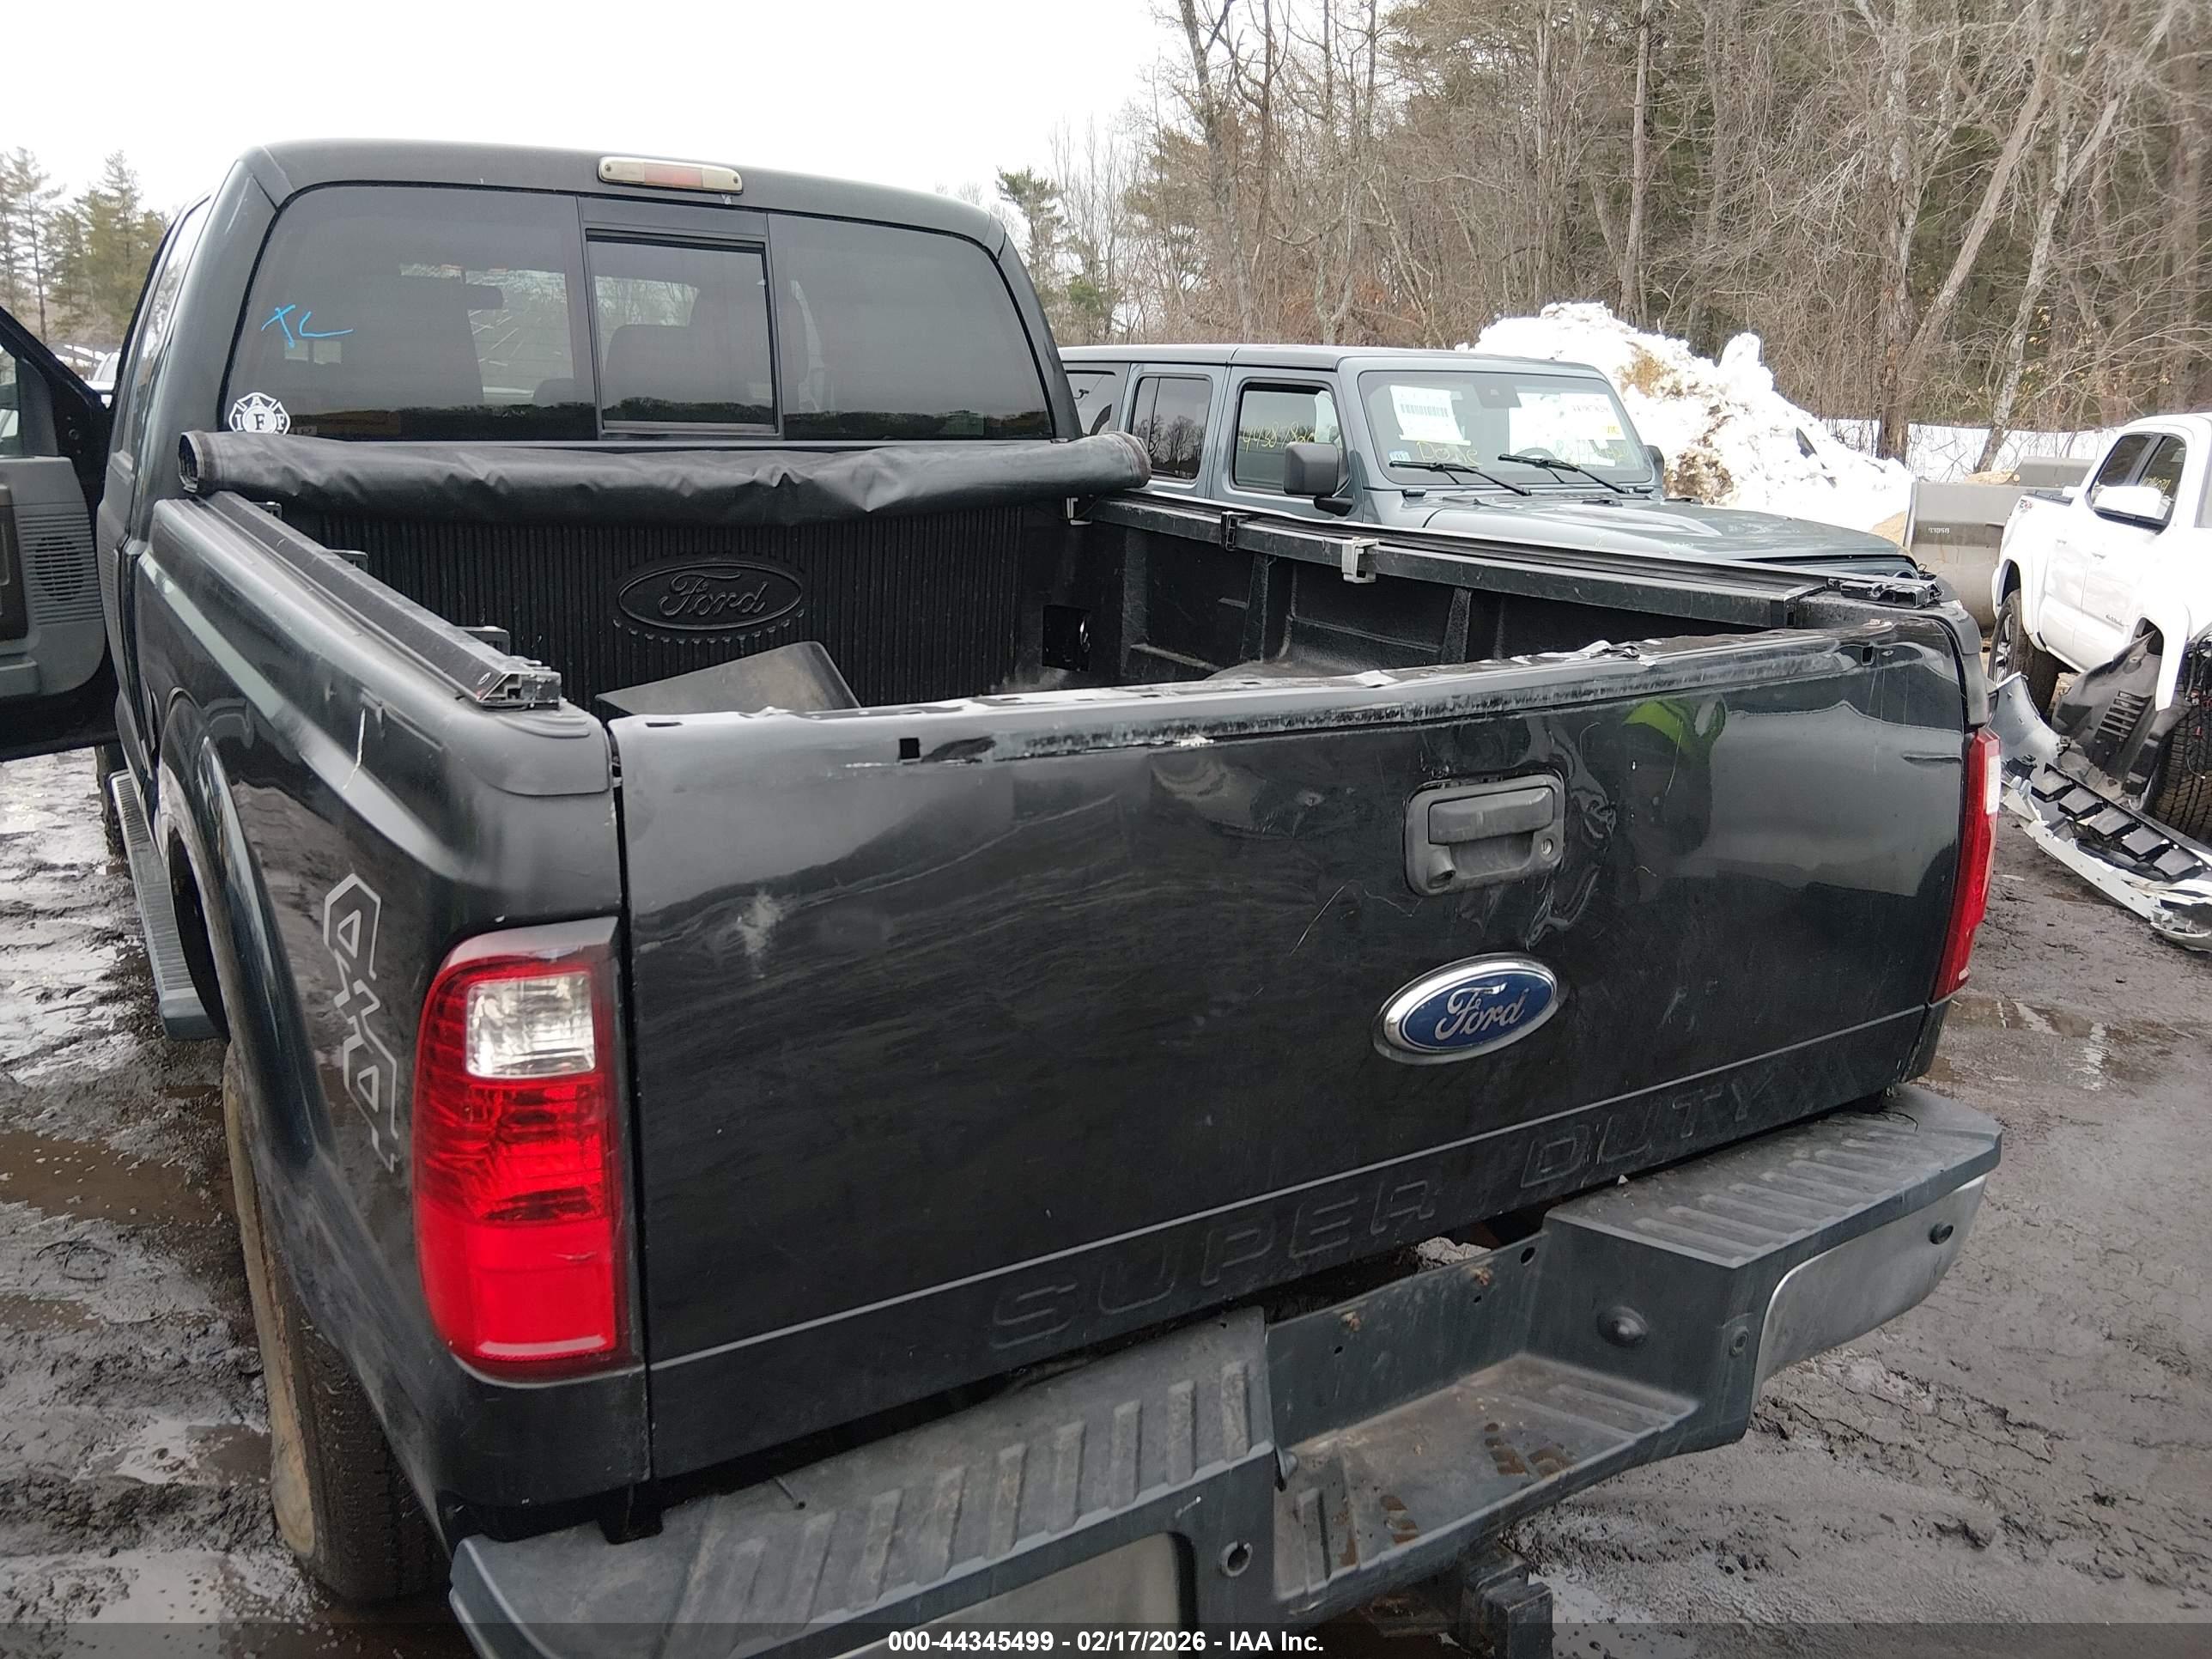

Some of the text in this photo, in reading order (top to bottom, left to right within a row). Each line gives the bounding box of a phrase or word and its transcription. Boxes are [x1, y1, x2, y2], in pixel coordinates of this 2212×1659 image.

[659, 571, 769, 616] Ford
[1434, 982, 1529, 1041] Ford
[990, 1072, 1777, 1350] SUPER DUTY
